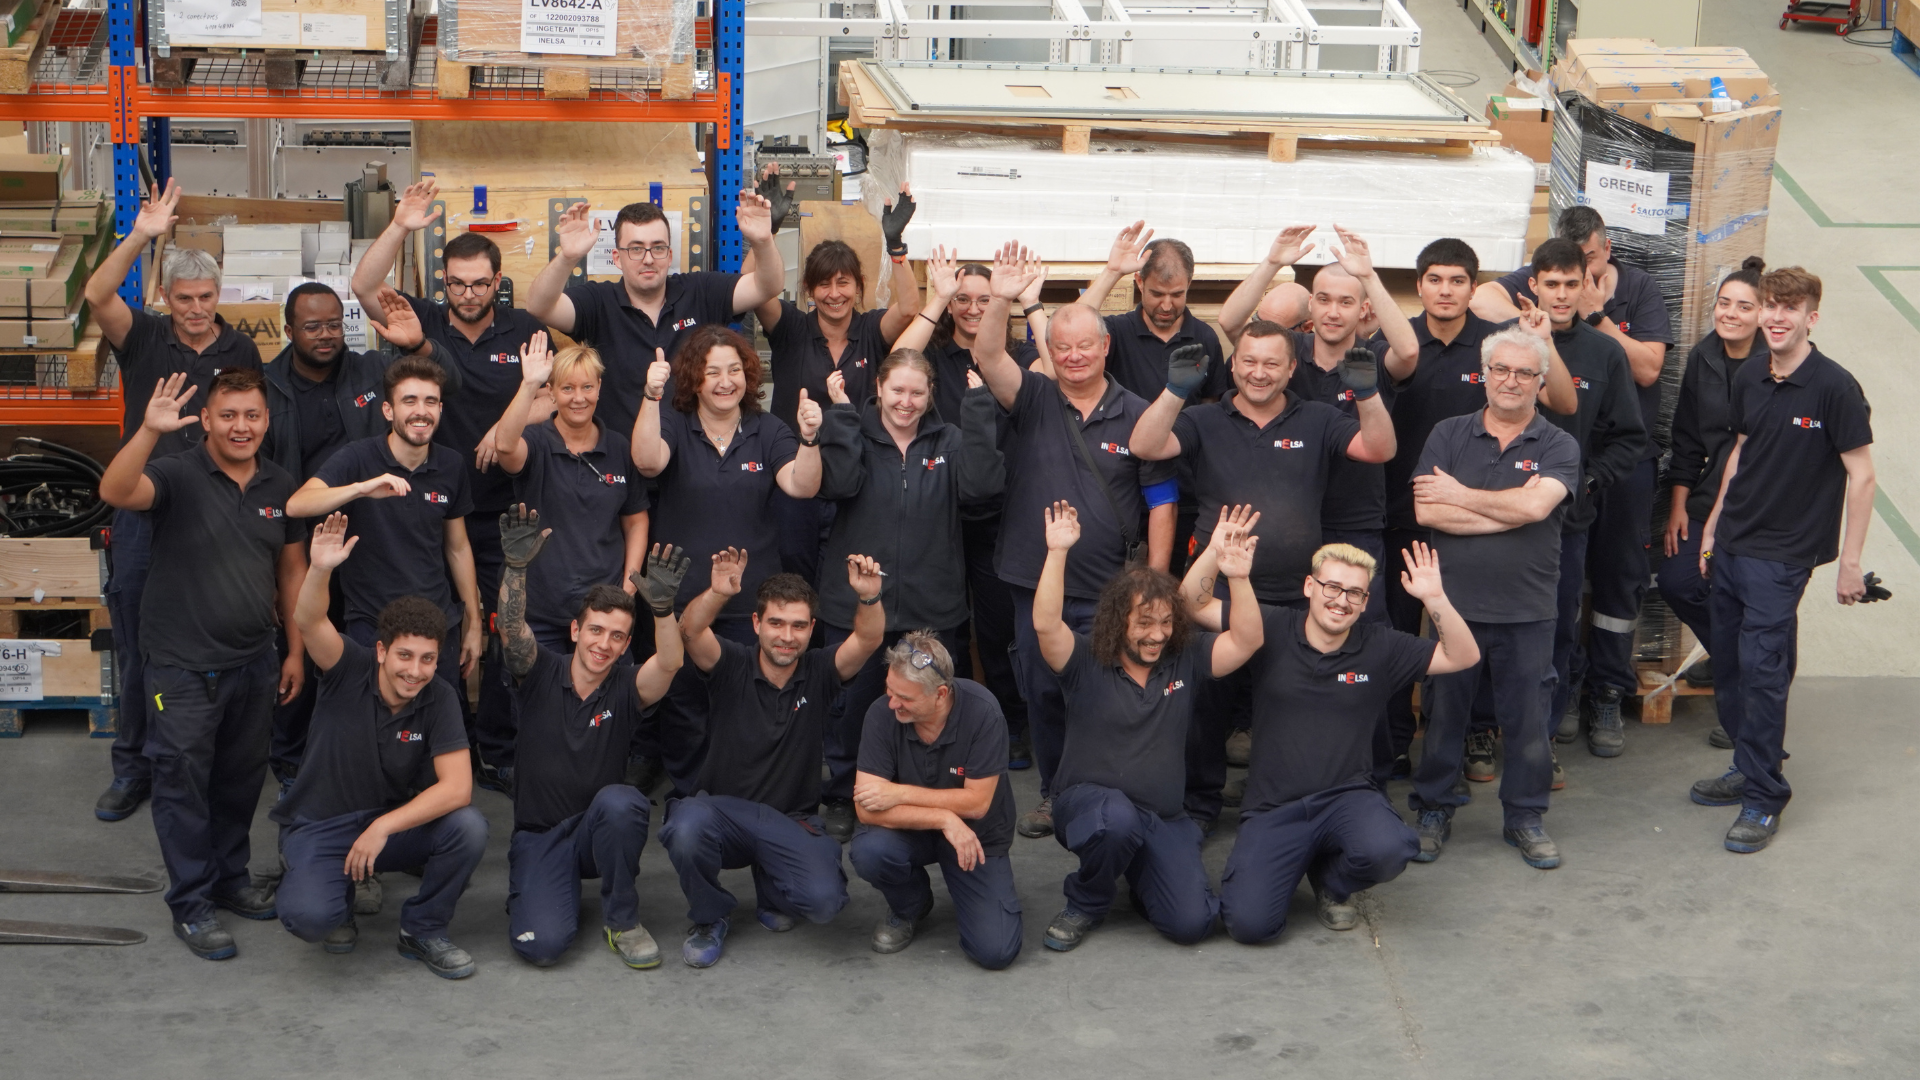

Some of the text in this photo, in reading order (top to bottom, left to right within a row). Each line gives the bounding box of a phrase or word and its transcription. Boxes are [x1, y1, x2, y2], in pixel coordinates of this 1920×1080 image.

[531, 0, 603, 10] LV8642-A
[545, 13, 600, 23] 122002093788
[536, 25, 575, 33] INGETEAM
[538, 37, 566, 45] INELSA
[1598, 176, 1654, 197] GREENE
[1636, 206, 1675, 216] SALTOKI
[673, 317, 698, 332] INELSA
[490, 352, 519, 364] INELSA
[1461, 372, 1487, 384] INELS
[1792, 416, 1822, 429] INELSA
[1100, 441, 1129, 456] INELSA
[1273, 438, 1304, 450] INELSA
[741, 461, 764, 472] INELS
[1514, 459, 1539, 472] INELS
[423, 491, 449, 504] INELSA
[258, 506, 284, 519] INELSA
[1337, 671, 1369, 684] INELSA
